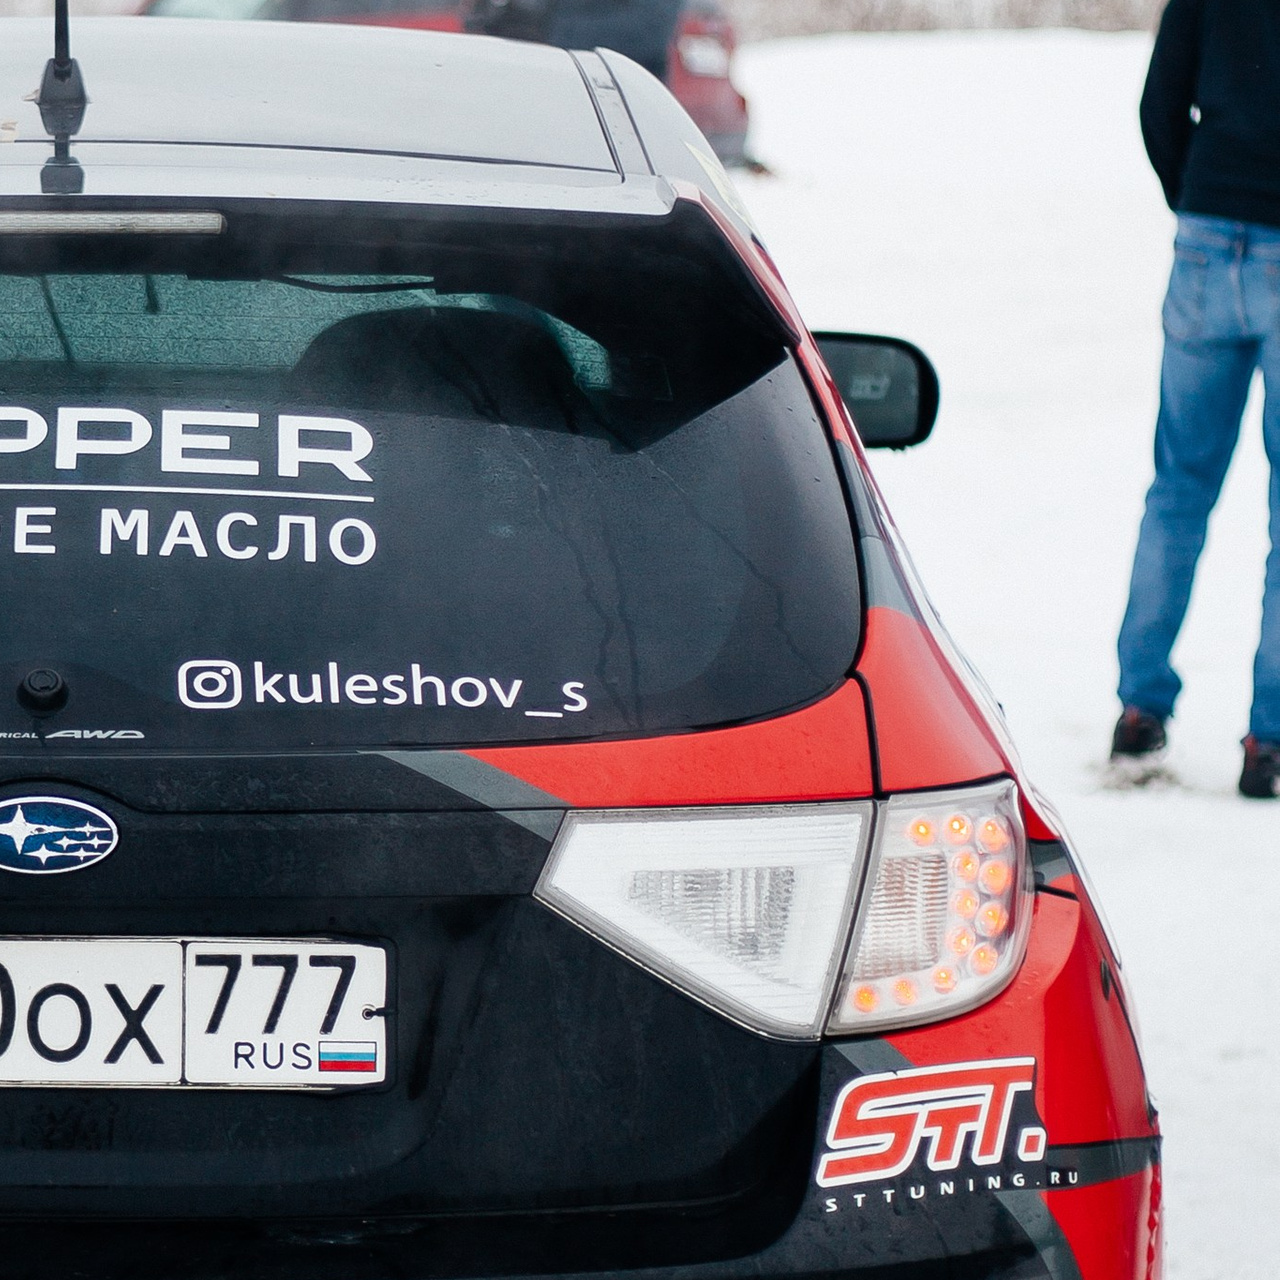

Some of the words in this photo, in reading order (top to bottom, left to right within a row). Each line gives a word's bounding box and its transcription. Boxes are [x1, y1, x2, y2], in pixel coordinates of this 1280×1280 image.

[99, 509, 377, 565] МАСЛО
[254, 661, 588, 718] kuleshov_s
[44, 729, 146, 739] AWD
[194, 954, 358, 1035] 777
[232, 1041, 314, 1070] RUS
[825, 1170, 1080, 1213] STTUNING.RU
